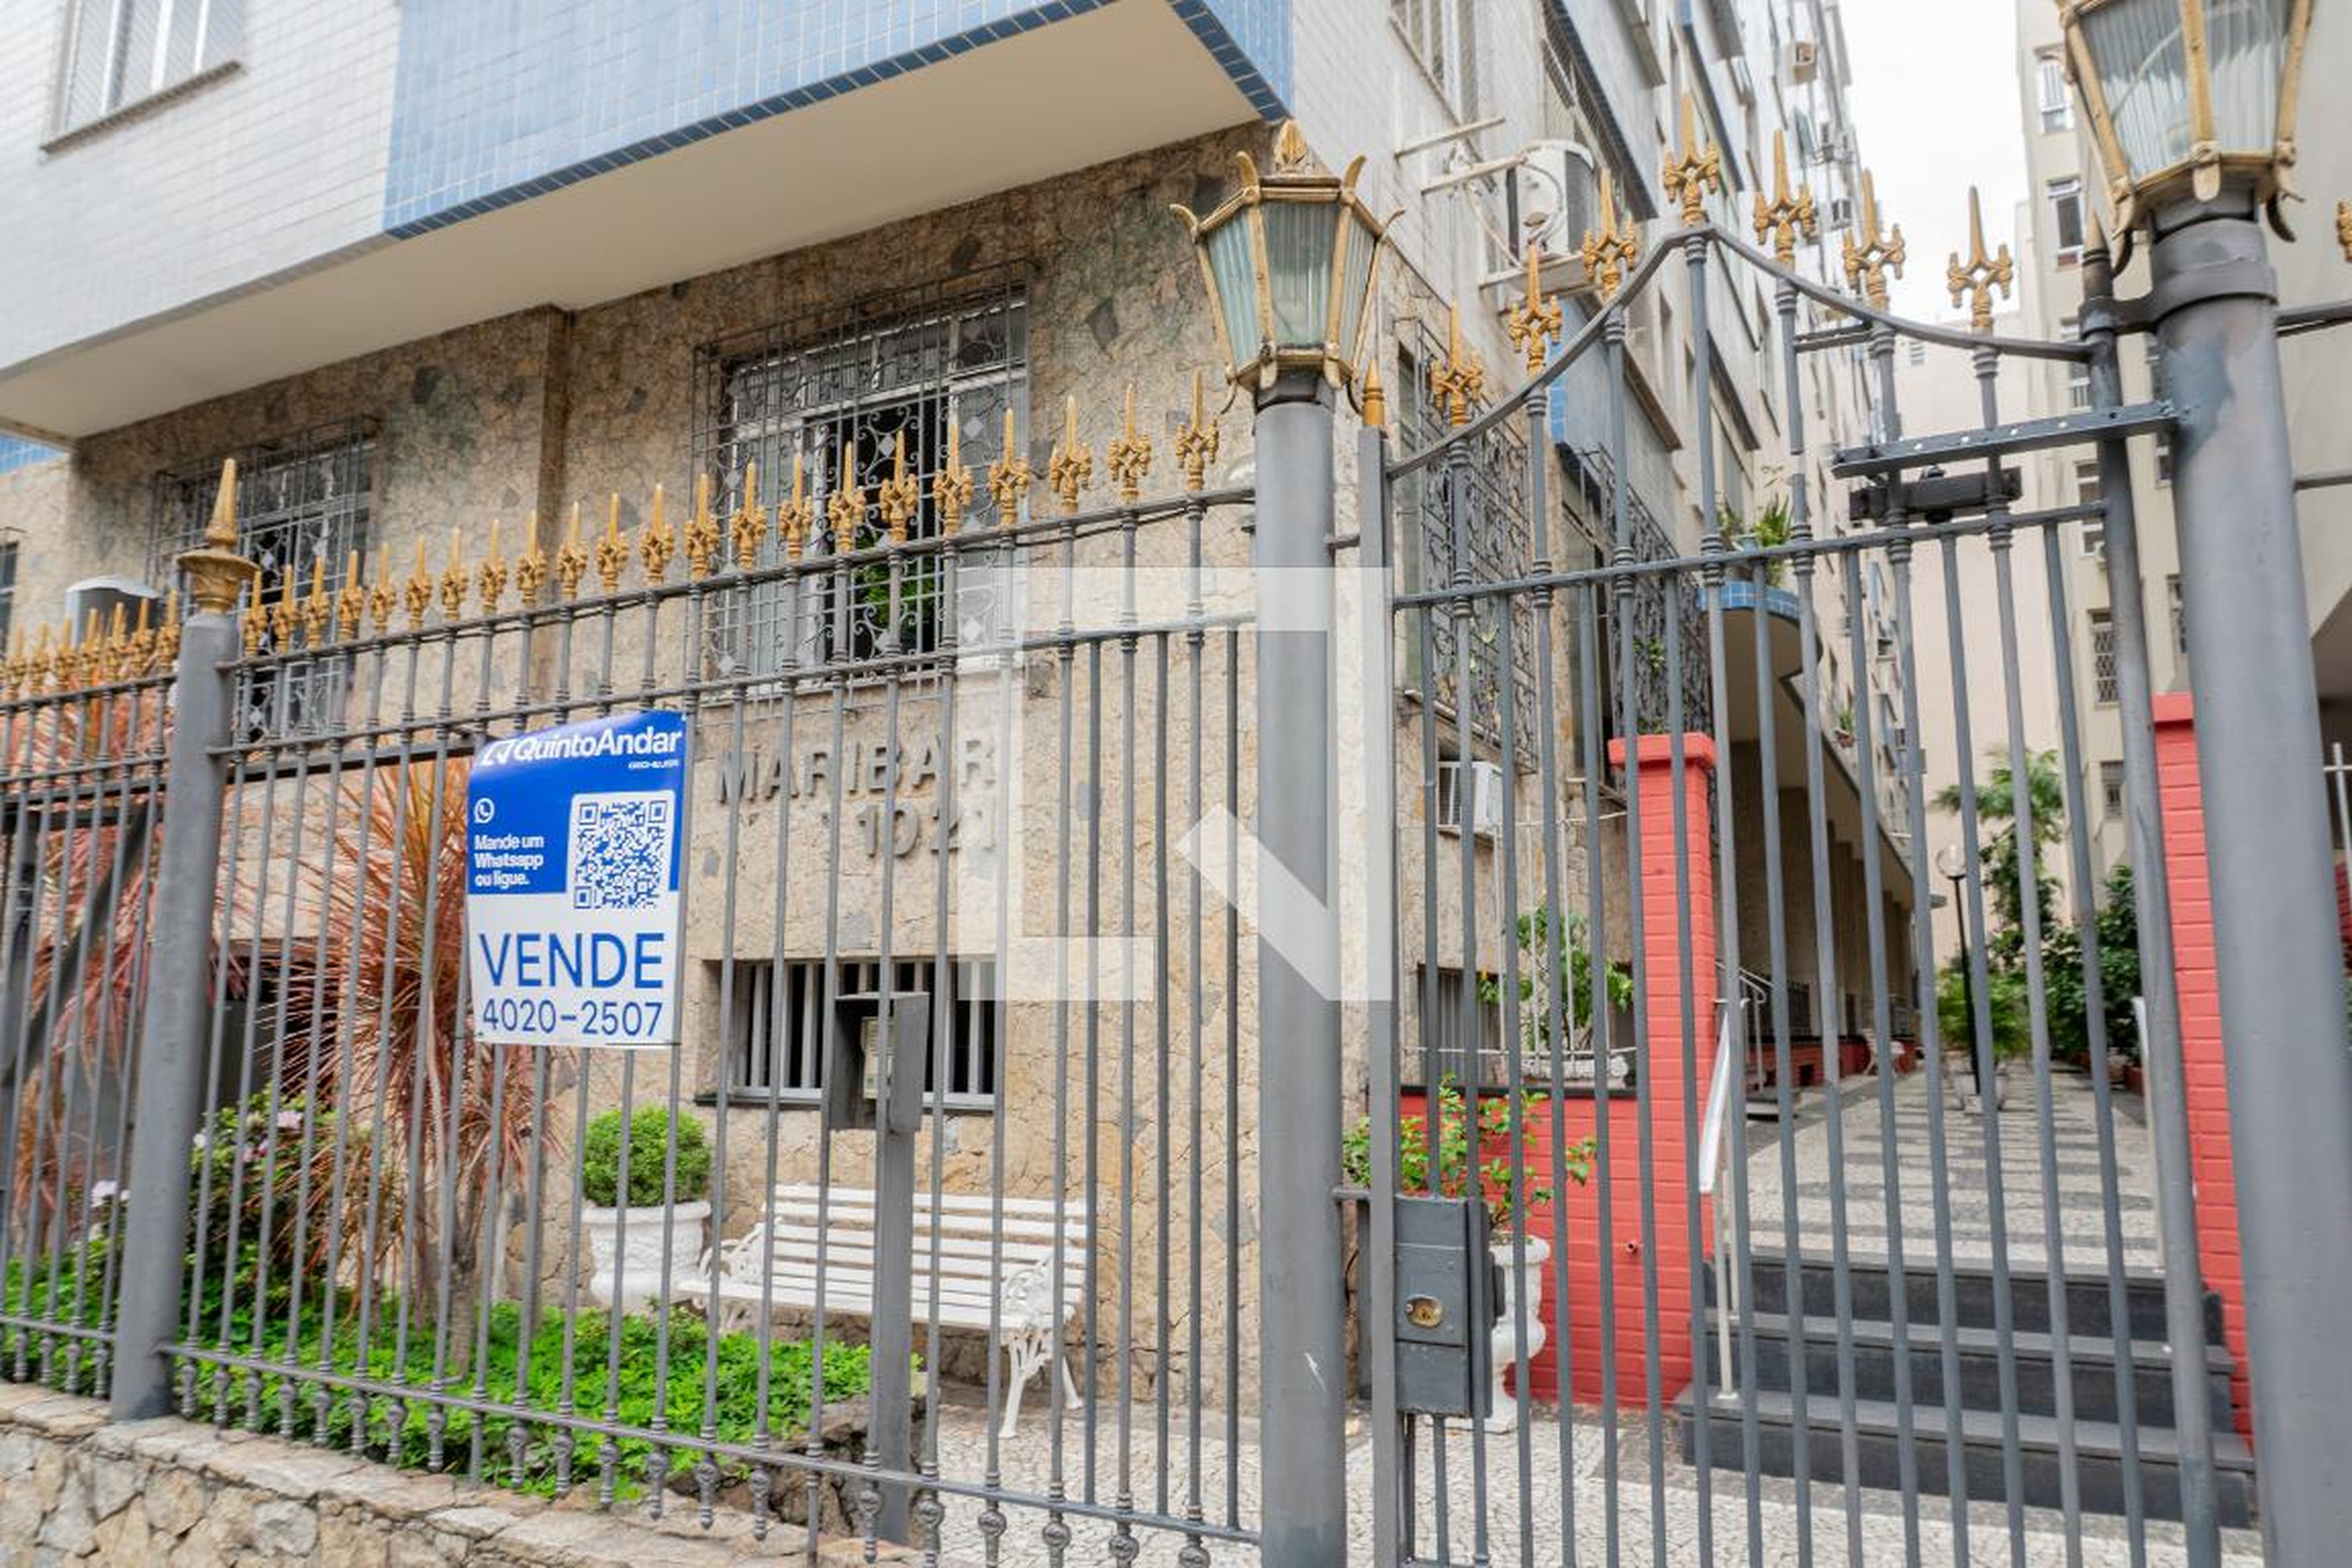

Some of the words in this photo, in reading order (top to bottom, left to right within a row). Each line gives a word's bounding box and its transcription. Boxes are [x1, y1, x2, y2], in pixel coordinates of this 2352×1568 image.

[514, 726, 682, 761] QuintoAndar
[474, 834, 521, 850] Mande
[522, 836, 544, 848] um
[475, 873, 492, 886] ou
[492, 870, 530, 889] ligue.
[479, 932, 665, 989] VENDE
[483, 998, 663, 1037] 4020-2507
